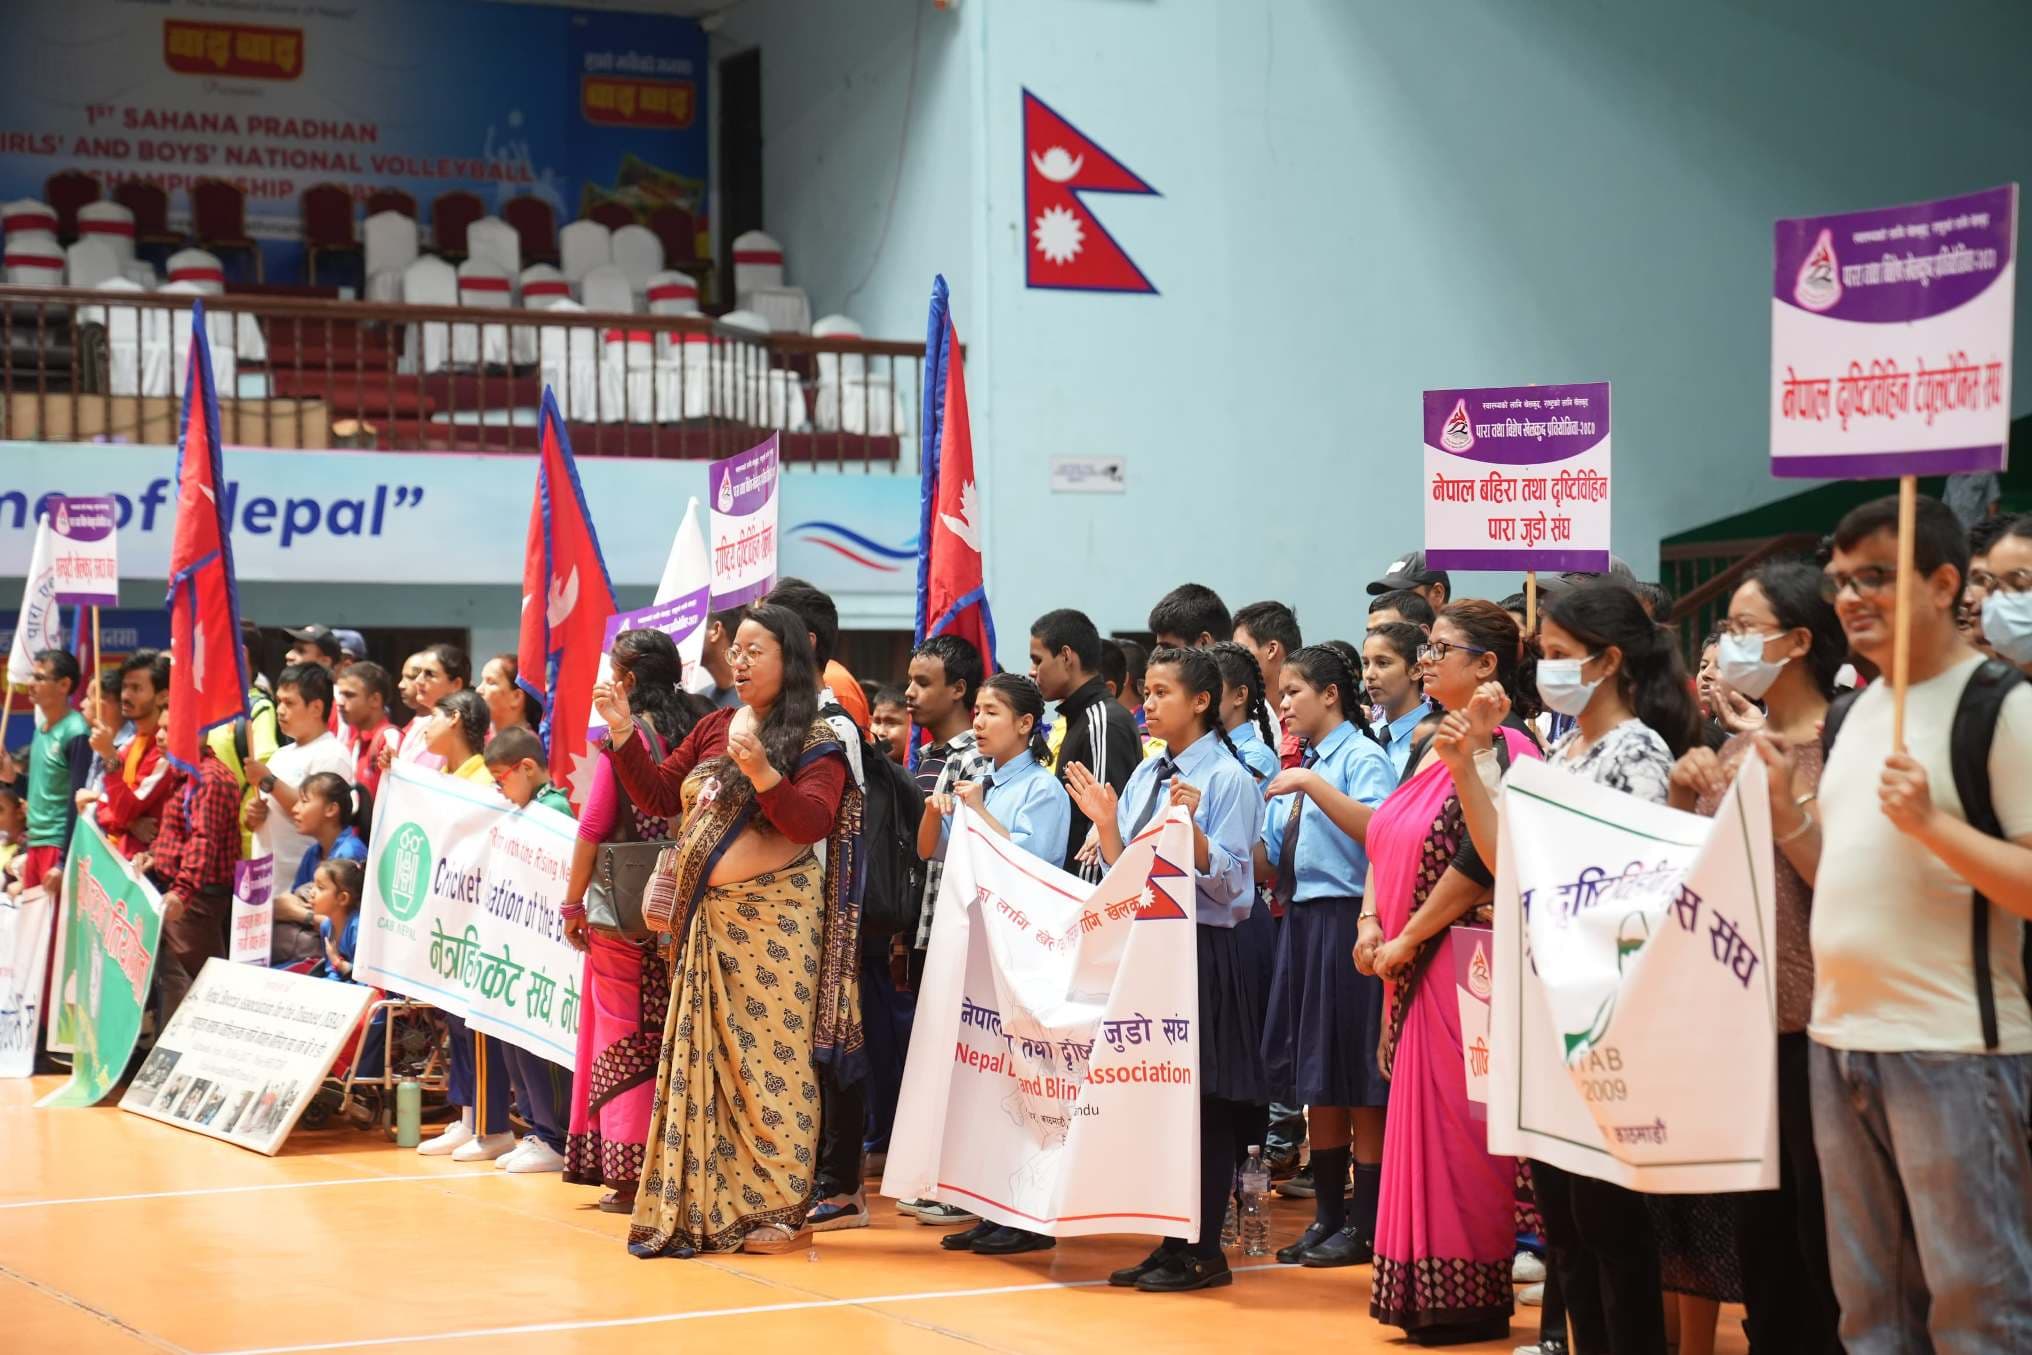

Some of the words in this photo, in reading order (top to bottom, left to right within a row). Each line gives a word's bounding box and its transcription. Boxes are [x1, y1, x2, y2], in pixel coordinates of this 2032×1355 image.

[123, 108, 239, 134] SAHANA
[247, 116, 378, 143] PRADHAN
[73, 136, 131, 158] AND
[225, 146, 363, 174] NATIONAL
[371, 155, 535, 183] VOLLEYBALL
[95, 168, 294, 199] CHAMPISHIP
[1782, 364, 1831, 421] नेपाल
[1475, 424, 1491, 438] पारा
[1491, 423, 1505, 438] तथा
[1432, 472, 1476, 503] नेपाल
[1479, 470, 1518, 504] बहिरा
[1521, 476, 1548, 502] तथा
[1551, 468, 1608, 508] दृष्टिविहिन
[224, 481, 425, 548] epal”
[1488, 517, 1516, 542] पारा
[1520, 510, 1547, 548] जुडो
[1550, 512, 1571, 542] संघ
[534, 847, 558, 881] Rising
[434, 856, 482, 905] Cricket
[537, 894, 554, 939] the
[996, 896, 1033, 931] लागि
[1710, 907, 1760, 989] संघ
[960, 996, 1003, 1037] नेपाल
[1103, 1012, 1153, 1054] जुडो
[1161, 1013, 1190, 1046] संघ
[954, 1041, 1005, 1074] Nepal
[1018, 1075, 1042, 1098] and
[1046, 1077, 1082, 1100] Blin
[1581, 1078, 1628, 1102] 2009
